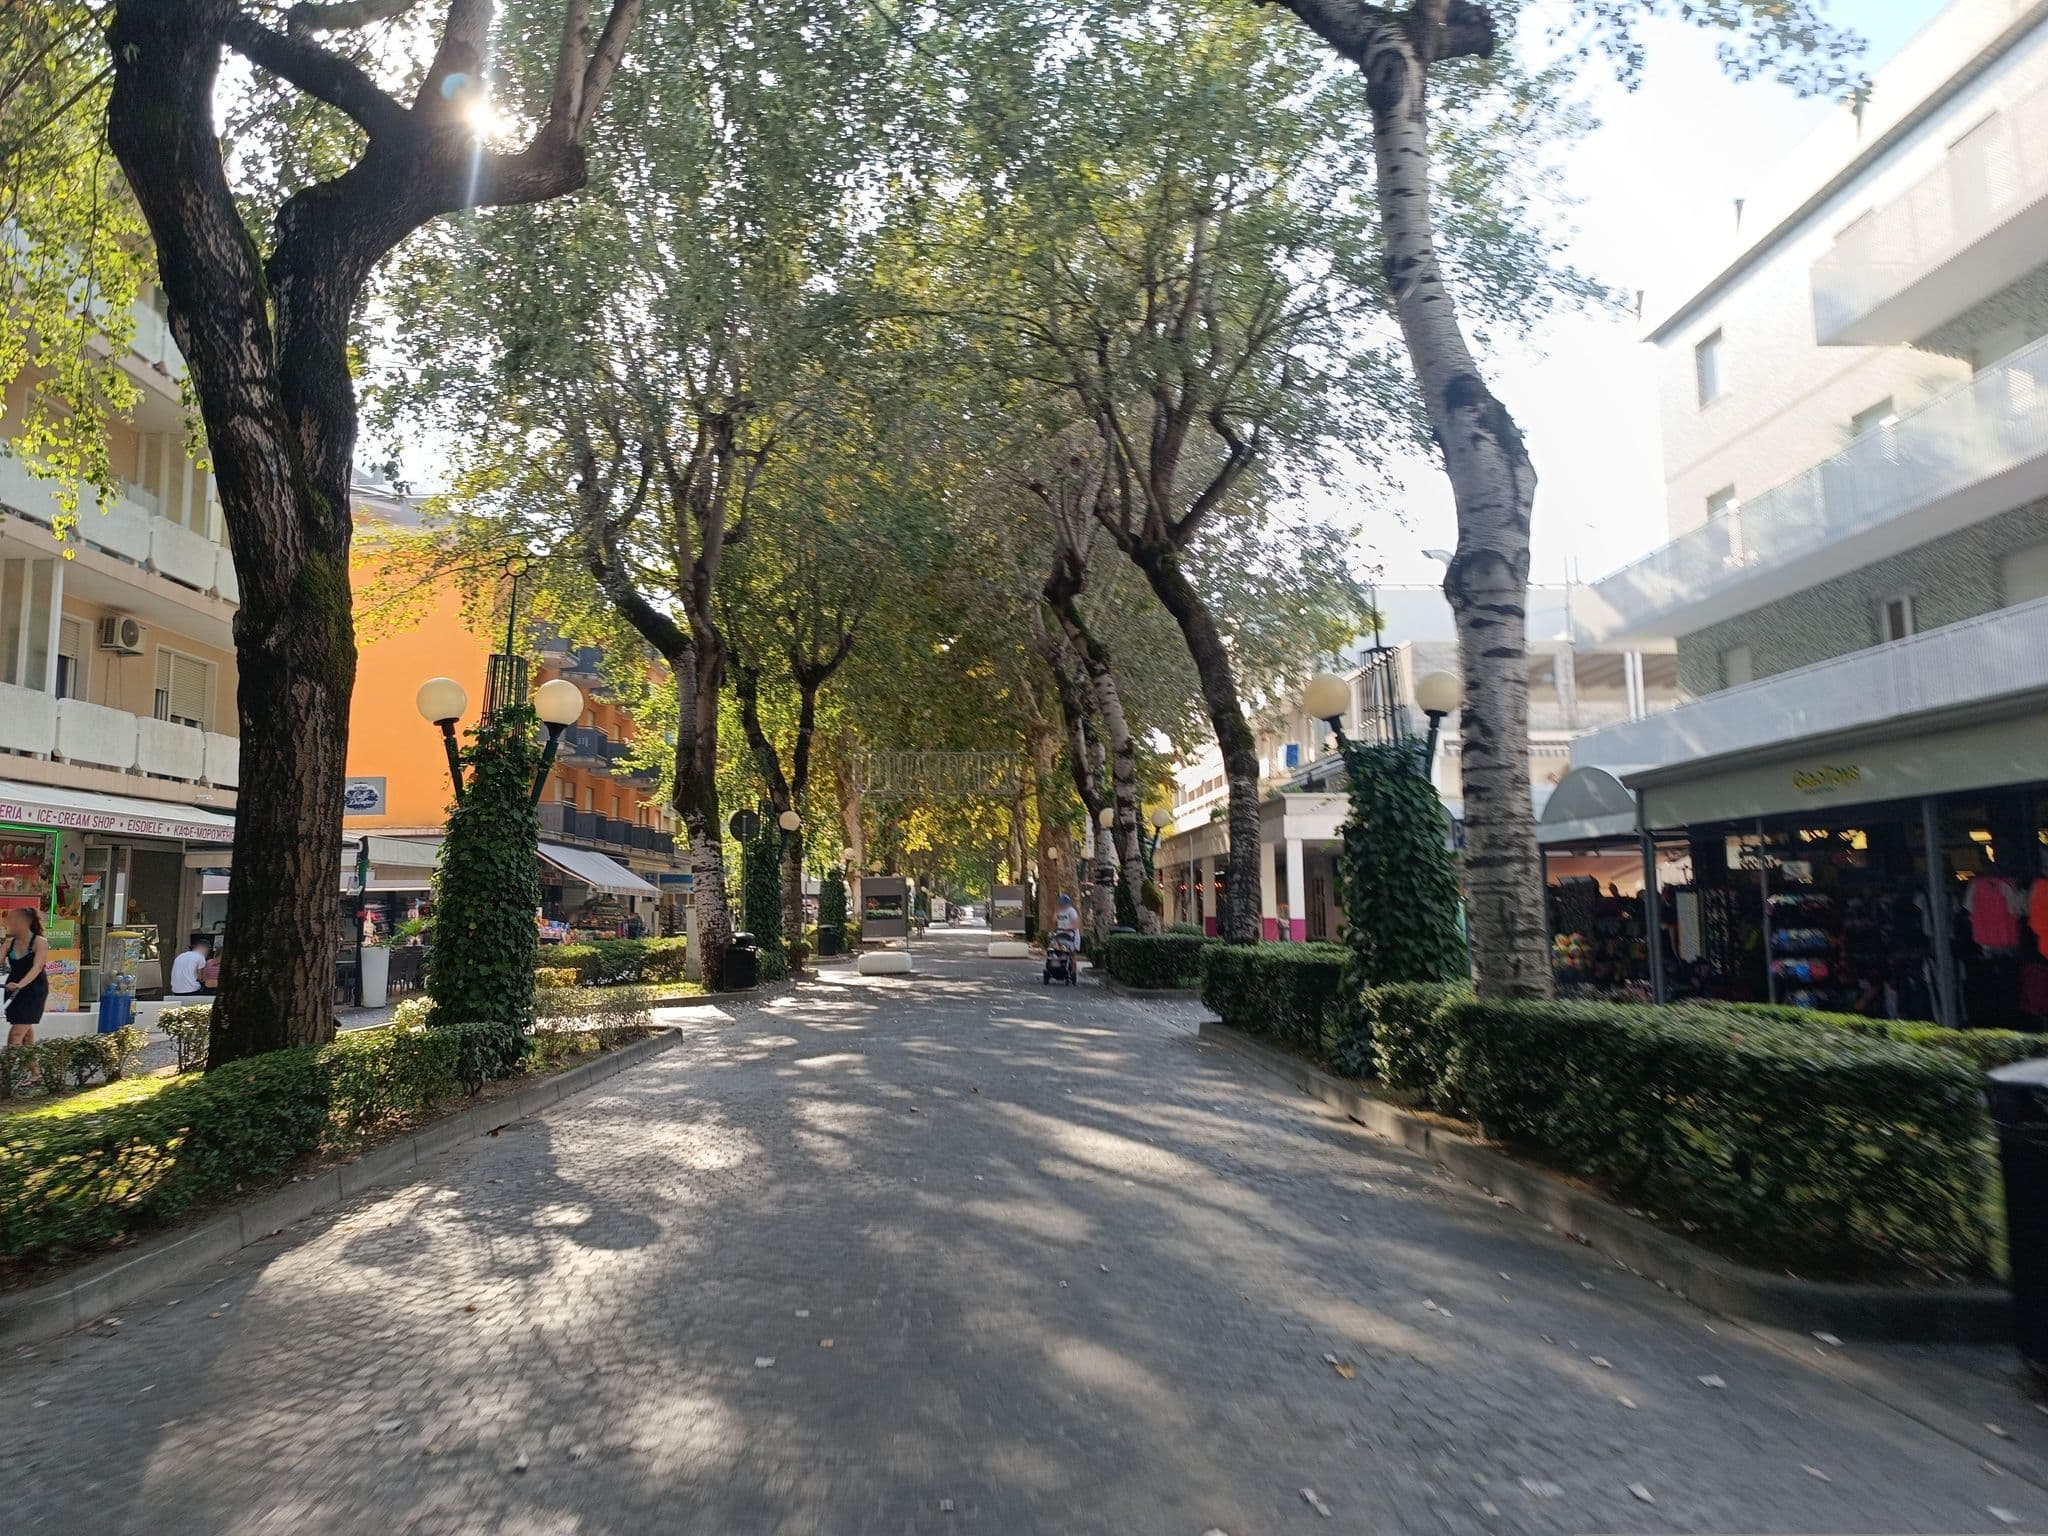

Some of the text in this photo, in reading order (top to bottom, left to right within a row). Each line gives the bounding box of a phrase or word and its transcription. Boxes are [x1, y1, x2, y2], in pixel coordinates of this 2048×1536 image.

[0, 804, 163, 834] ERIA ICE-CREAM SHOP EISDIELE
